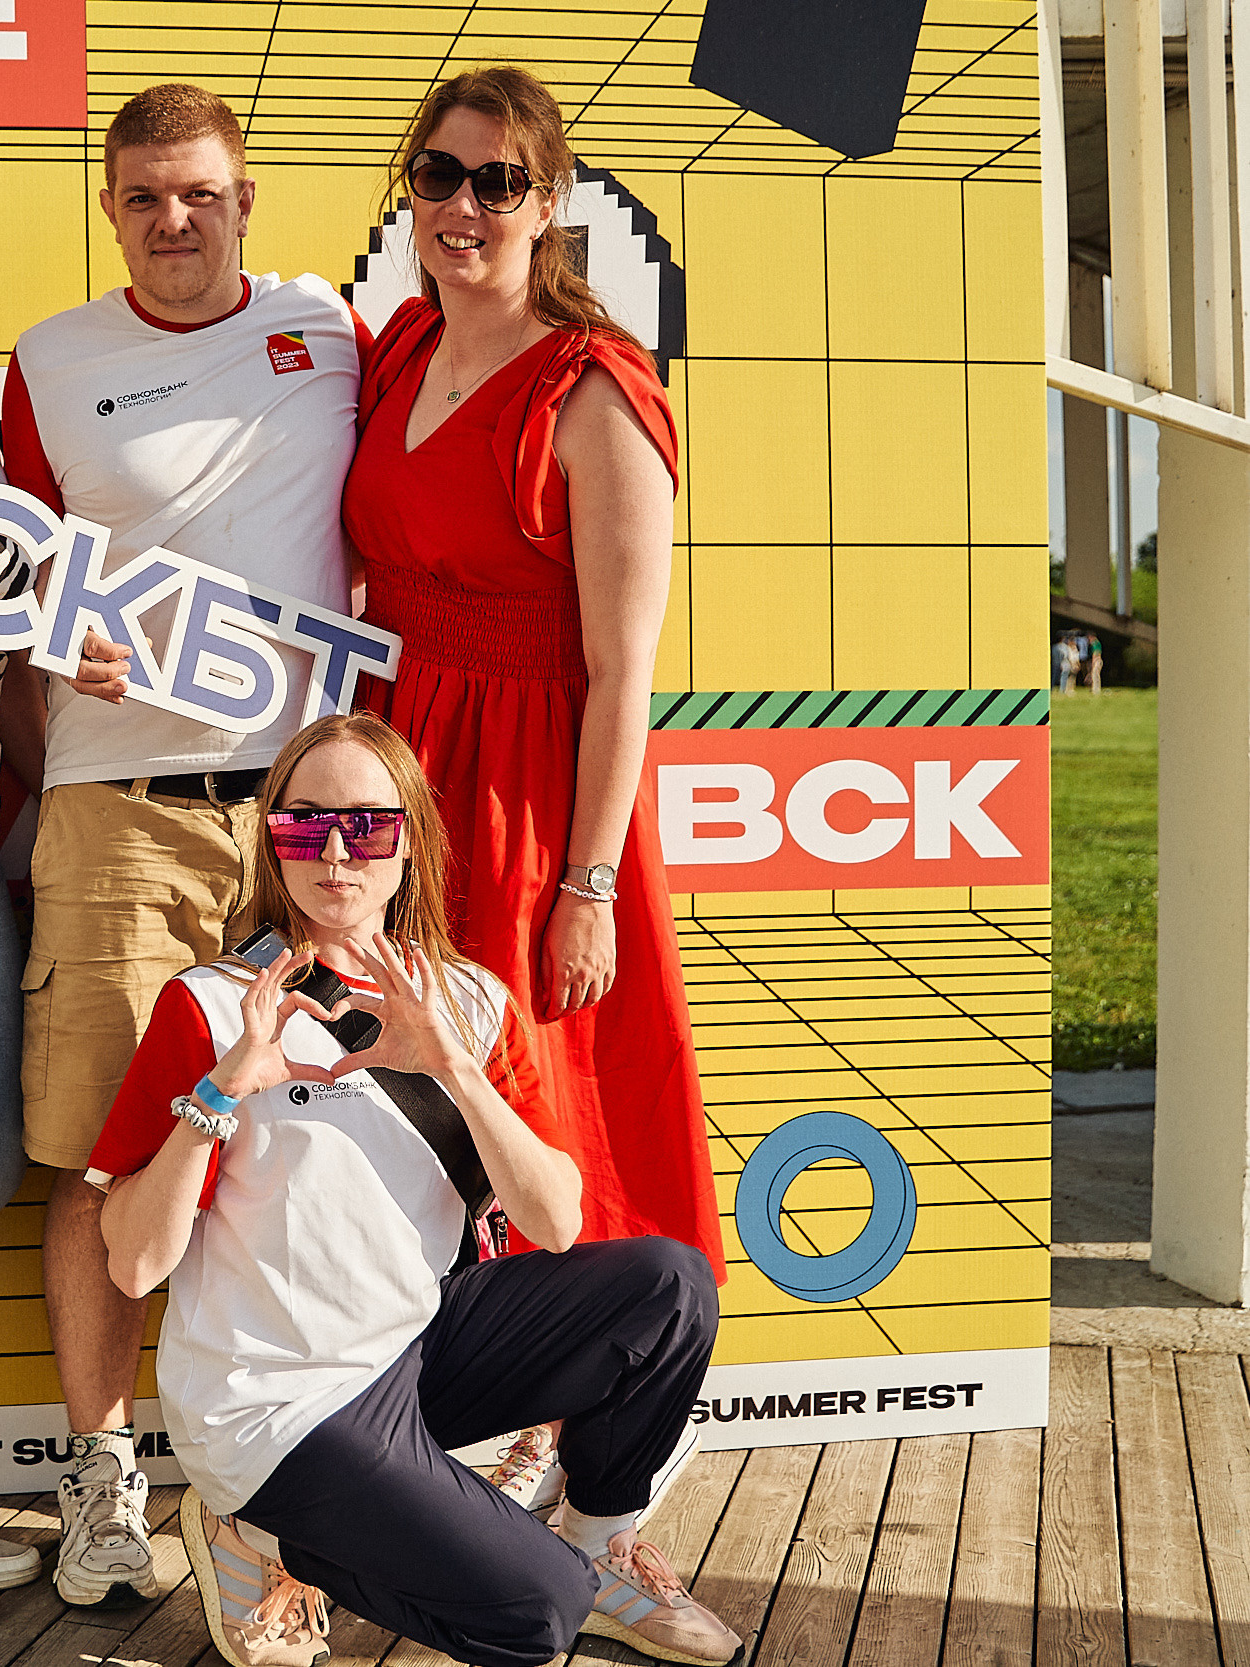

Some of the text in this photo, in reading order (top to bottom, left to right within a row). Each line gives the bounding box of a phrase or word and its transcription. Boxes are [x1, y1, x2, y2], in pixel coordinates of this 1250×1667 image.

[116, 380, 188, 404] СОВКОМБАНК
[118, 392, 172, 410] ТЕХНОЛОГИИ
[689, 1383, 984, 1425] SUMMER FEST
